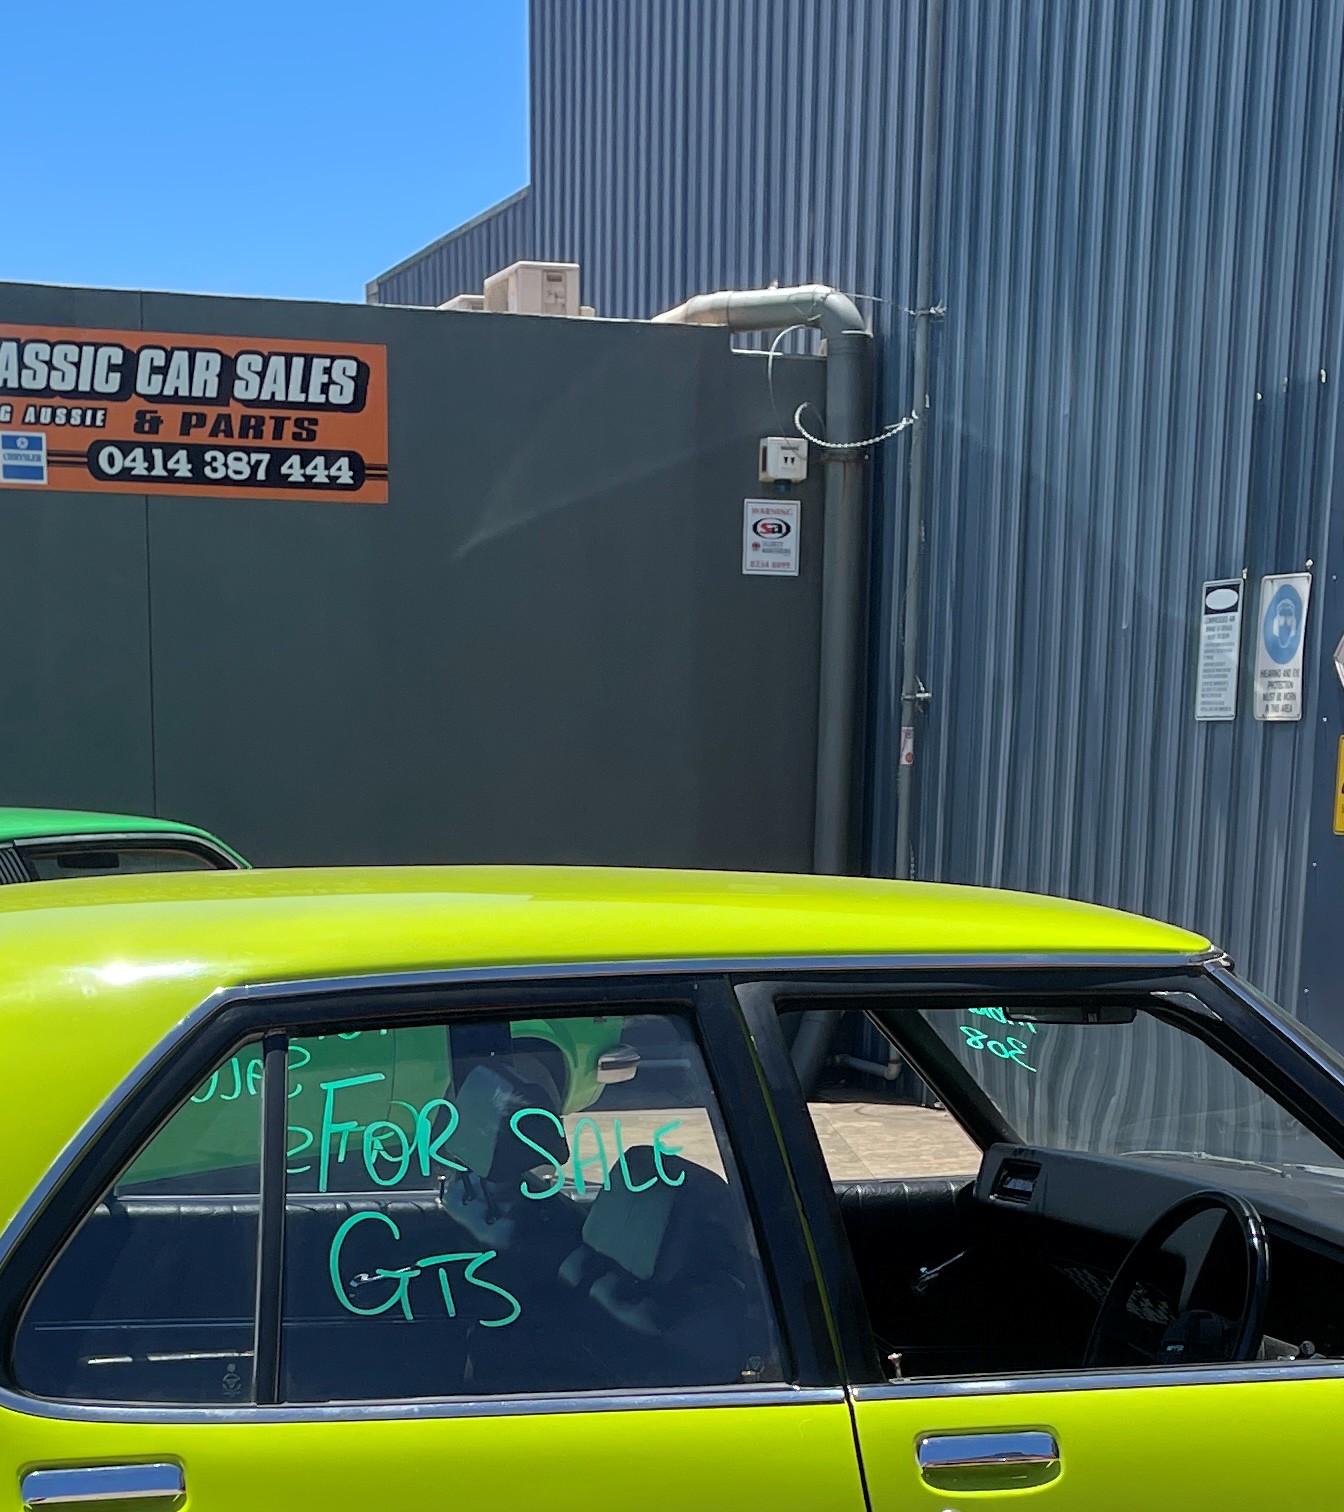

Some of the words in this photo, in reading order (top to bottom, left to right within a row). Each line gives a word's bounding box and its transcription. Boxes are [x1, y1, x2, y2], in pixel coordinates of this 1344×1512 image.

[136, 348, 222, 398] CAR
[233, 353, 358, 405] SALES
[23, 405, 108, 427] AUSSIE
[133, 409, 164, 436] &
[179, 411, 319, 442] PARTS
[97, 445, 193, 478] 0414
[203, 450, 271, 481] 387
[280, 454, 355, 485] 444
[319, 1073, 469, 1192] FOR
[509, 1107, 689, 1202] SALE
[329, 1210, 523, 1328] GTS
